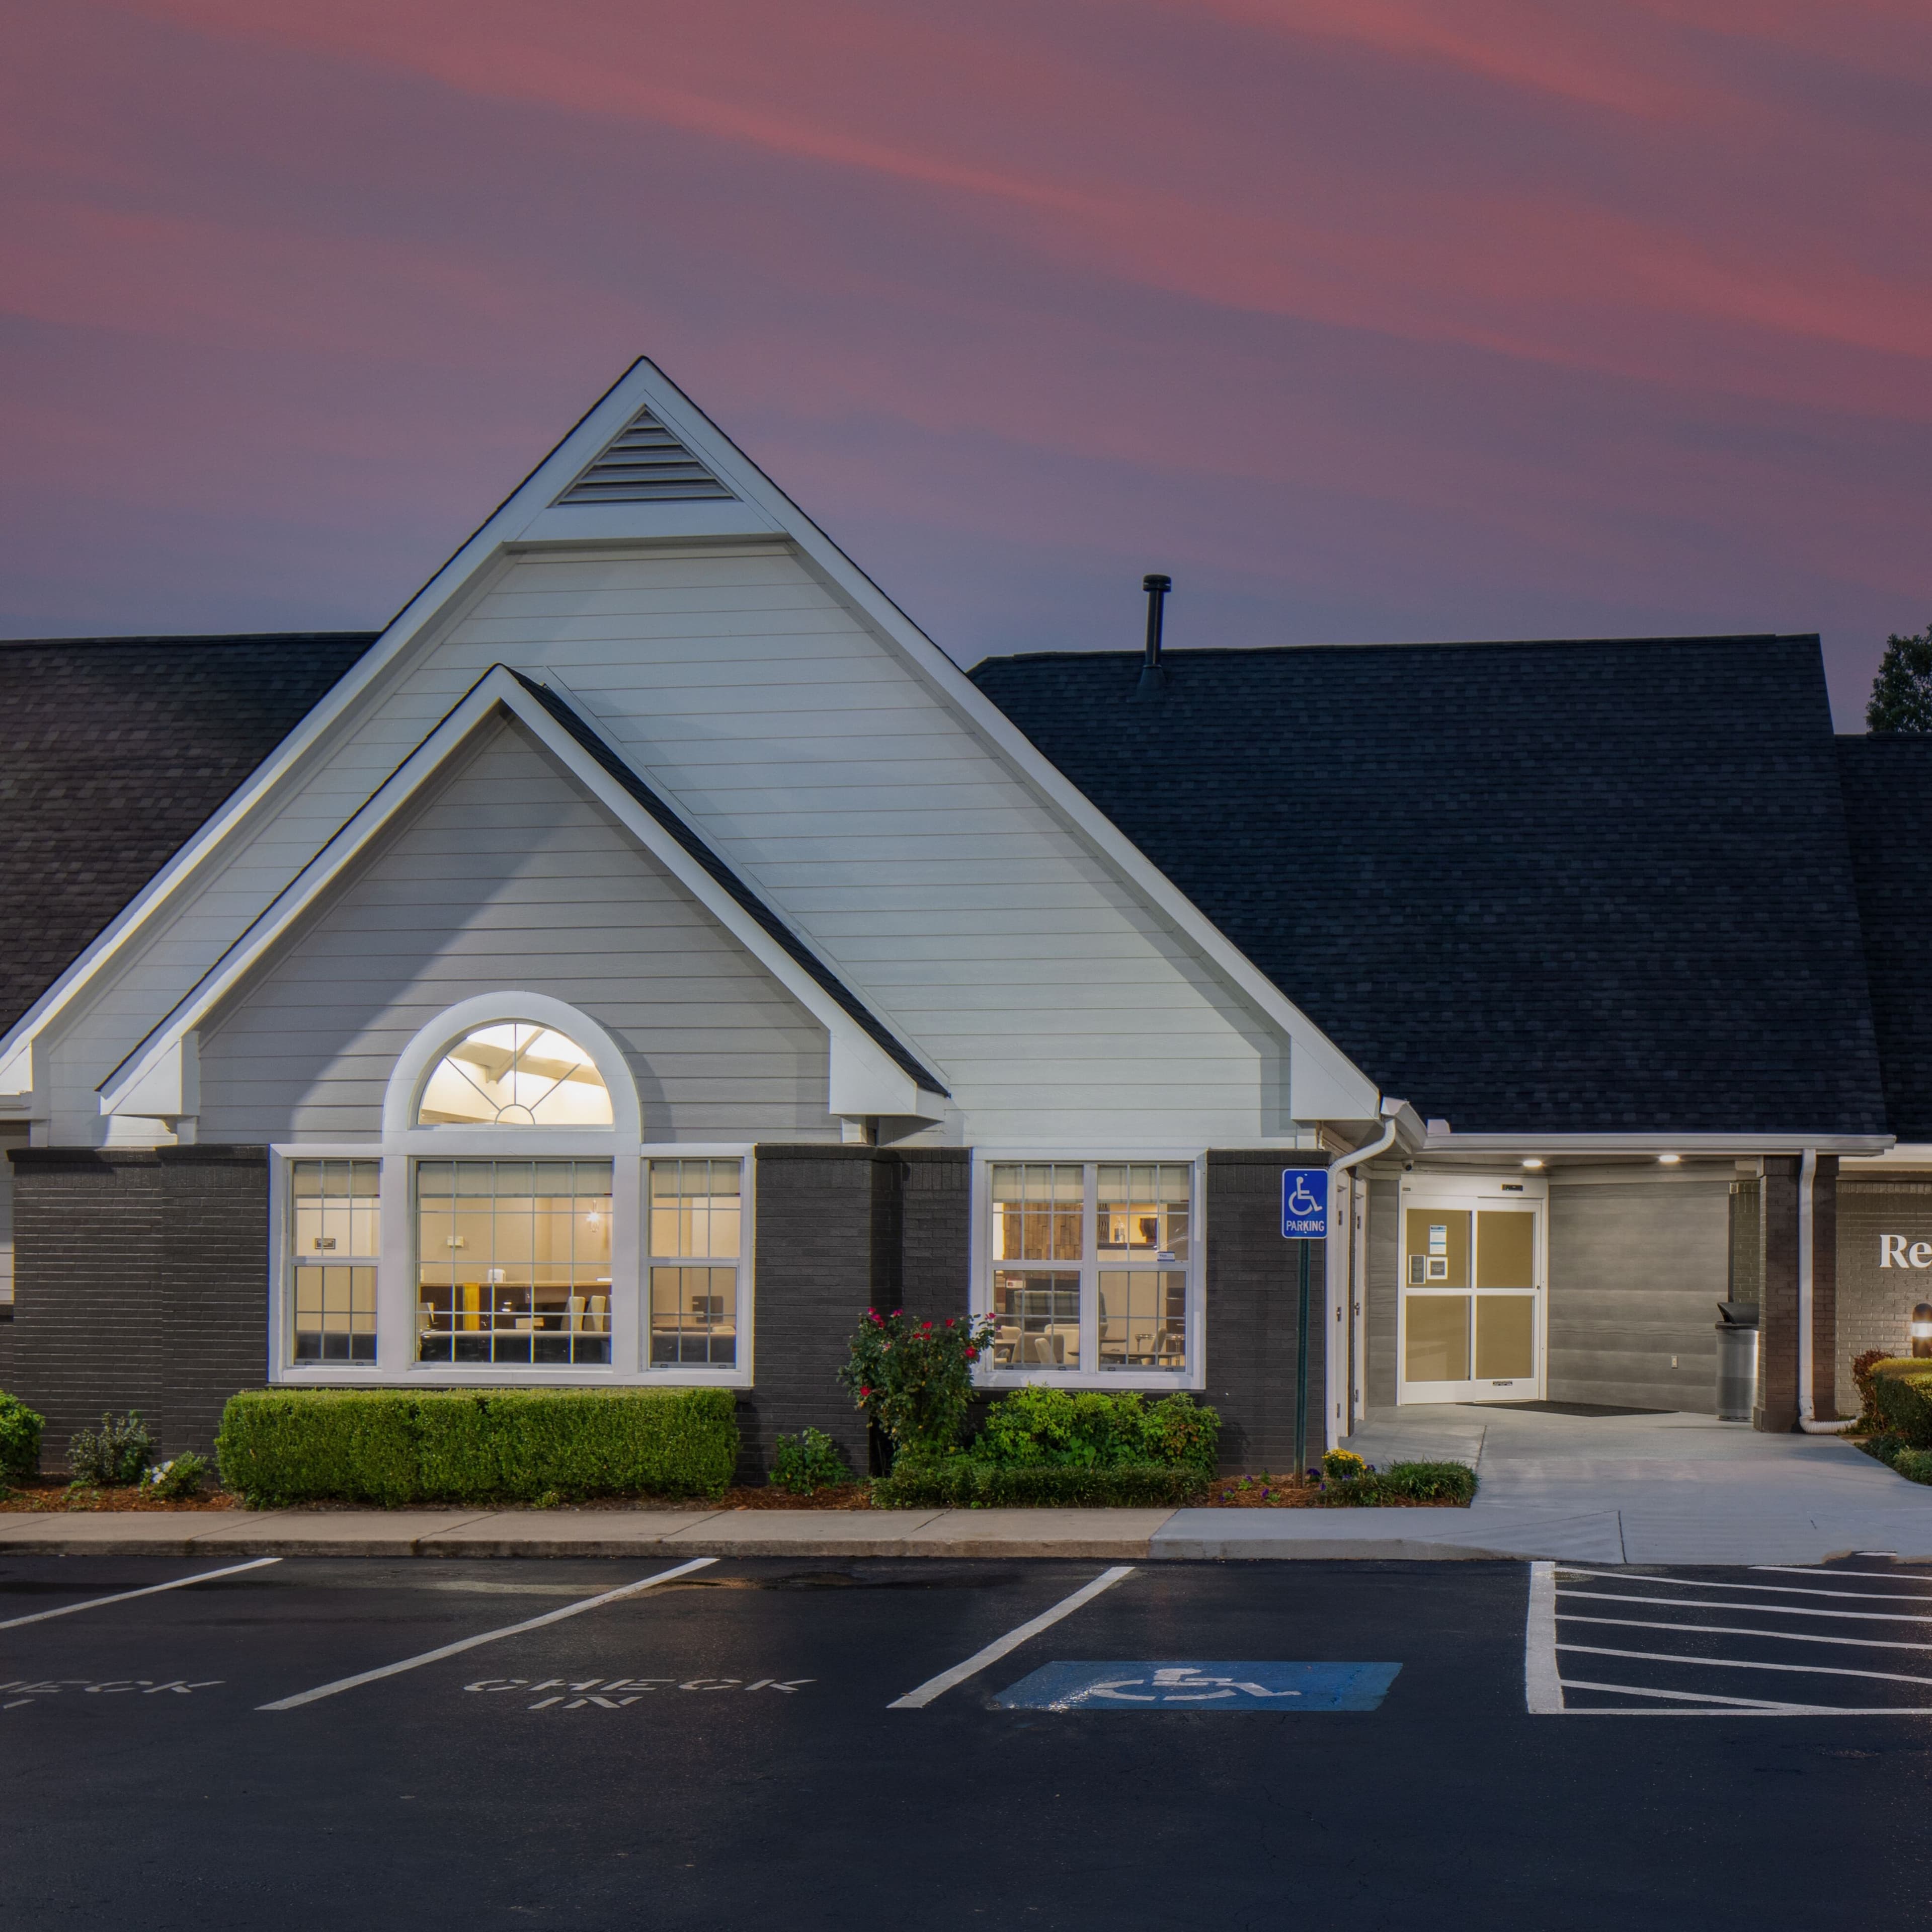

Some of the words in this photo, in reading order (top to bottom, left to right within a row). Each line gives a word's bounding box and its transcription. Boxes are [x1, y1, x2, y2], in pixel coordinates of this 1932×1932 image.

[1286, 1220, 1325, 1231] PARKING
[463, 1679, 817, 1691] CHECK
[527, 1697, 643, 1709] IN
